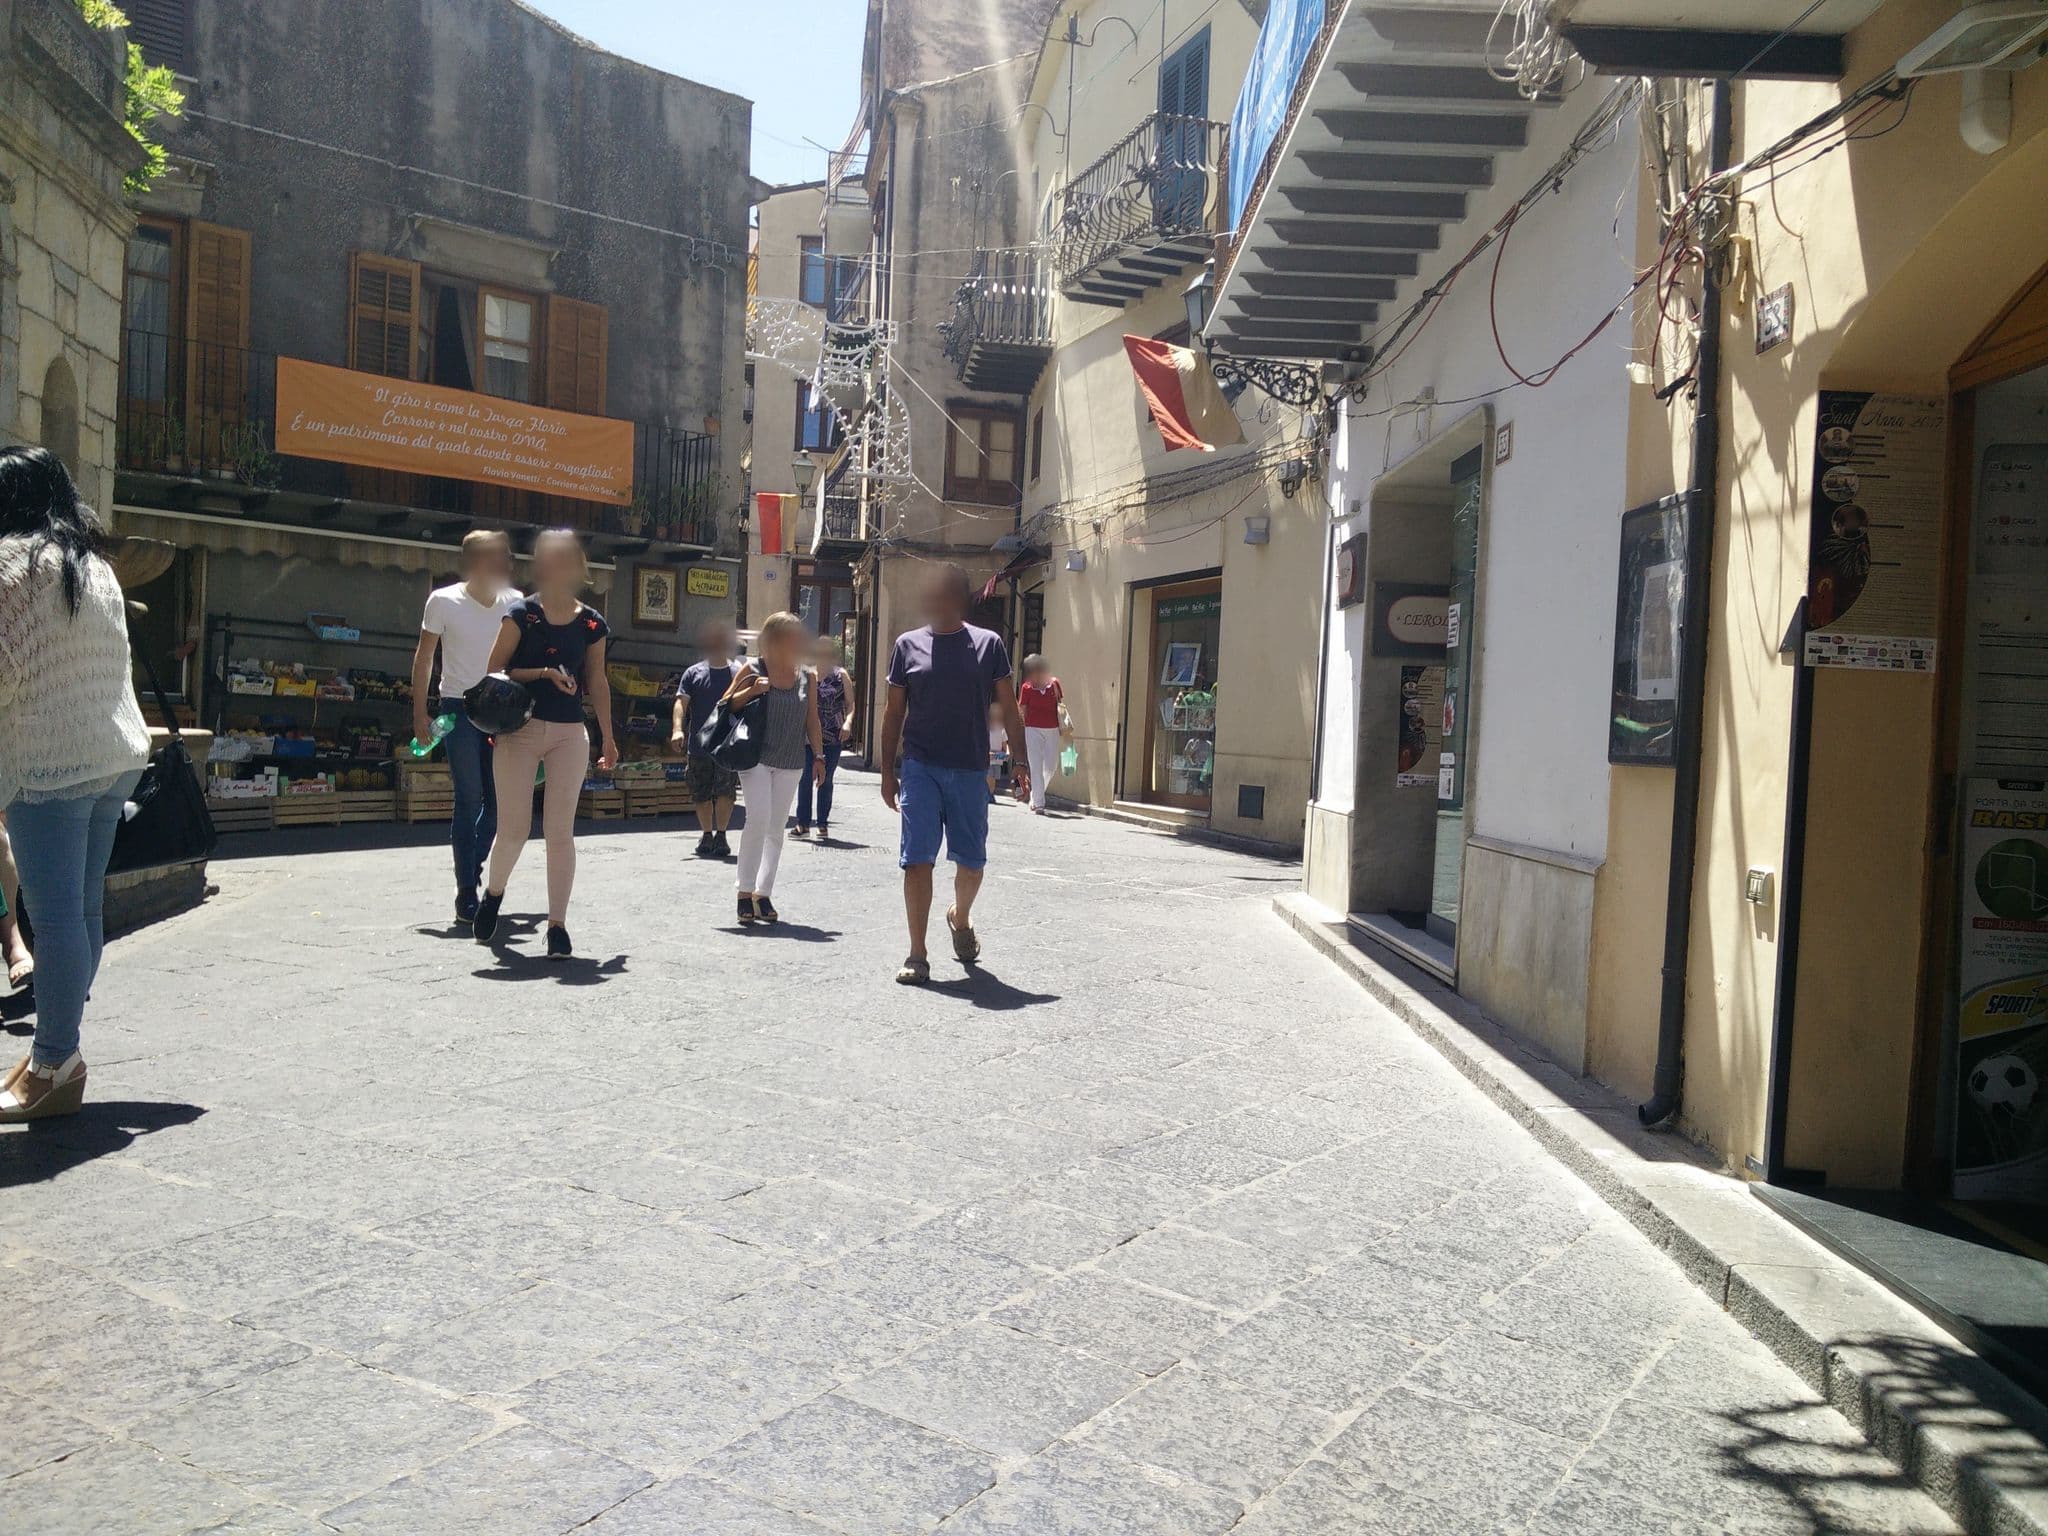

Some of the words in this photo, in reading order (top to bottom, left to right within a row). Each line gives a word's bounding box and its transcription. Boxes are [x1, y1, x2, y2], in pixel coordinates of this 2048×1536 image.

[382, 409, 435, 429] Correre
[449, 421, 468, 435] nel
[470, 427, 508, 442] vostro
[392, 391, 420, 408] giro
[433, 401, 465, 415] come
[467, 403, 480, 418] la
[483, 407, 524, 428] Targa
[526, 416, 567, 436] Florio.
[305, 420, 325, 433] un
[328, 420, 410, 446] patrimonio
[411, 434, 433, 449] del
[435, 439, 471, 455] quale
[473, 443, 512, 461] dovete
[514, 453, 551, 469] essere
[482, 466, 509, 479] Flavio
[546, 476, 578, 491] Corriere
